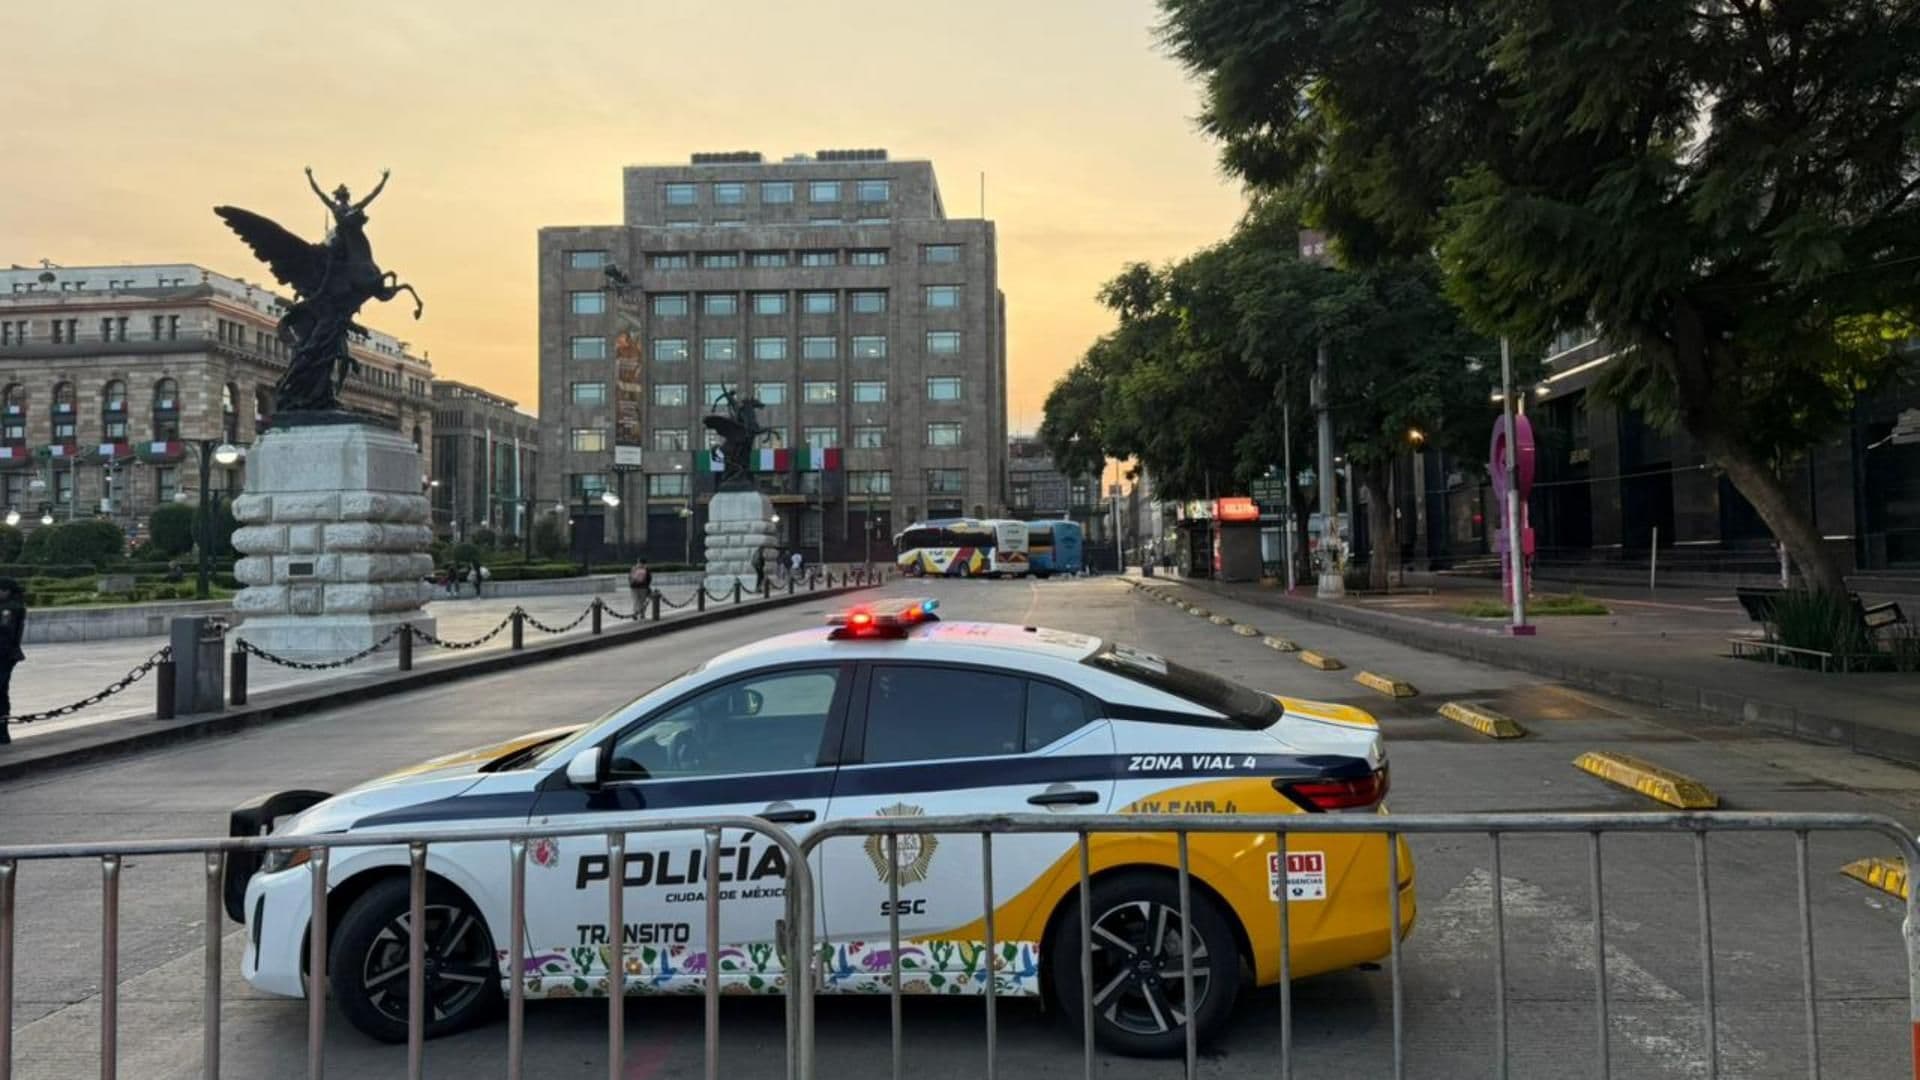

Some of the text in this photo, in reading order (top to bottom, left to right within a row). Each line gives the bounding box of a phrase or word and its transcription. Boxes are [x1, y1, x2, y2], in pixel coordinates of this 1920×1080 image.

[1128, 756, 1256, 771] ZONA VIAL 4
[576, 832, 788, 890] POLICÍA
[665, 891, 716, 903] CIUDA
[719, 891, 736, 900] DE
[880, 899, 926, 916] SSC
[577, 923, 690, 945] TRNSITO
